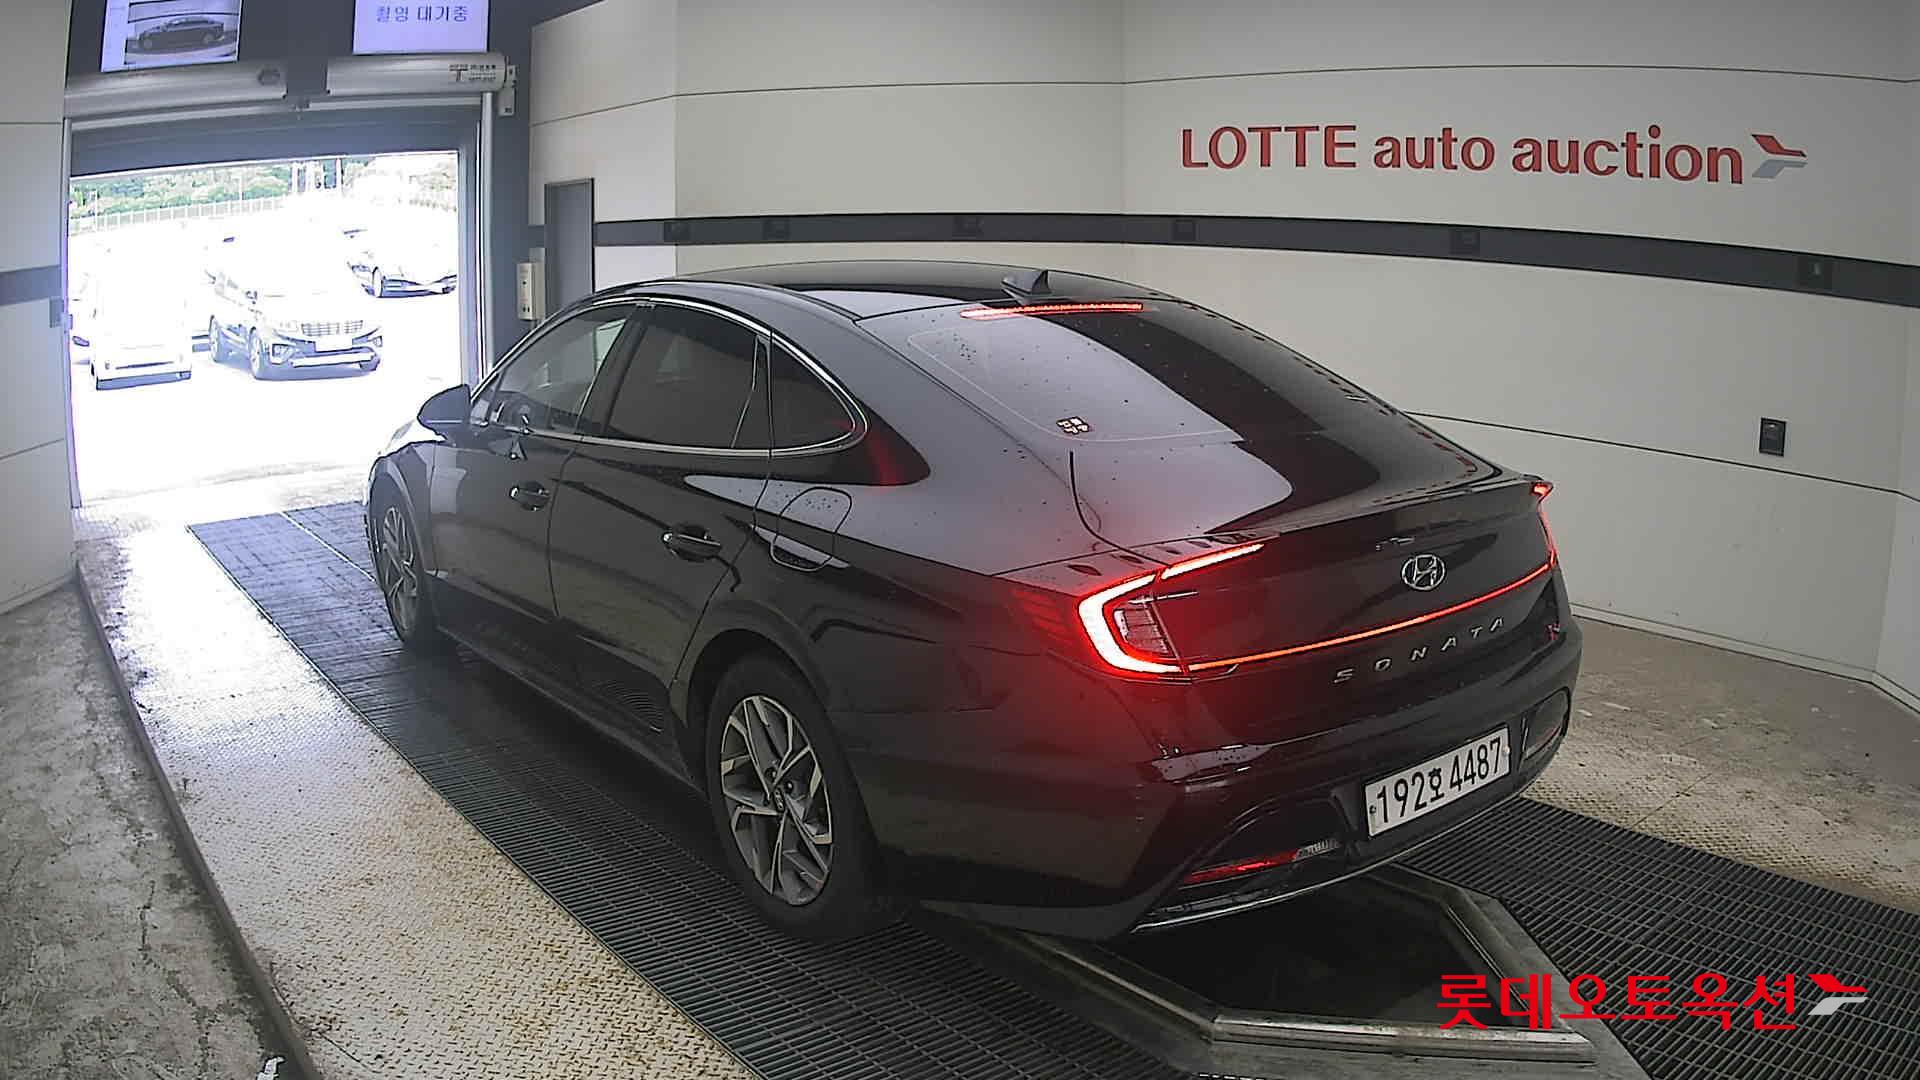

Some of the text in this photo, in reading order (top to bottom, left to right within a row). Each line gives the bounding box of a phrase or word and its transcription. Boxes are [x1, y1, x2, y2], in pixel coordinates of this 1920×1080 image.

[417, 4, 467, 22] 대기중
[1182, 124, 1743, 184] LOTTE auto auction
[1333, 616, 1505, 684] SONATA
